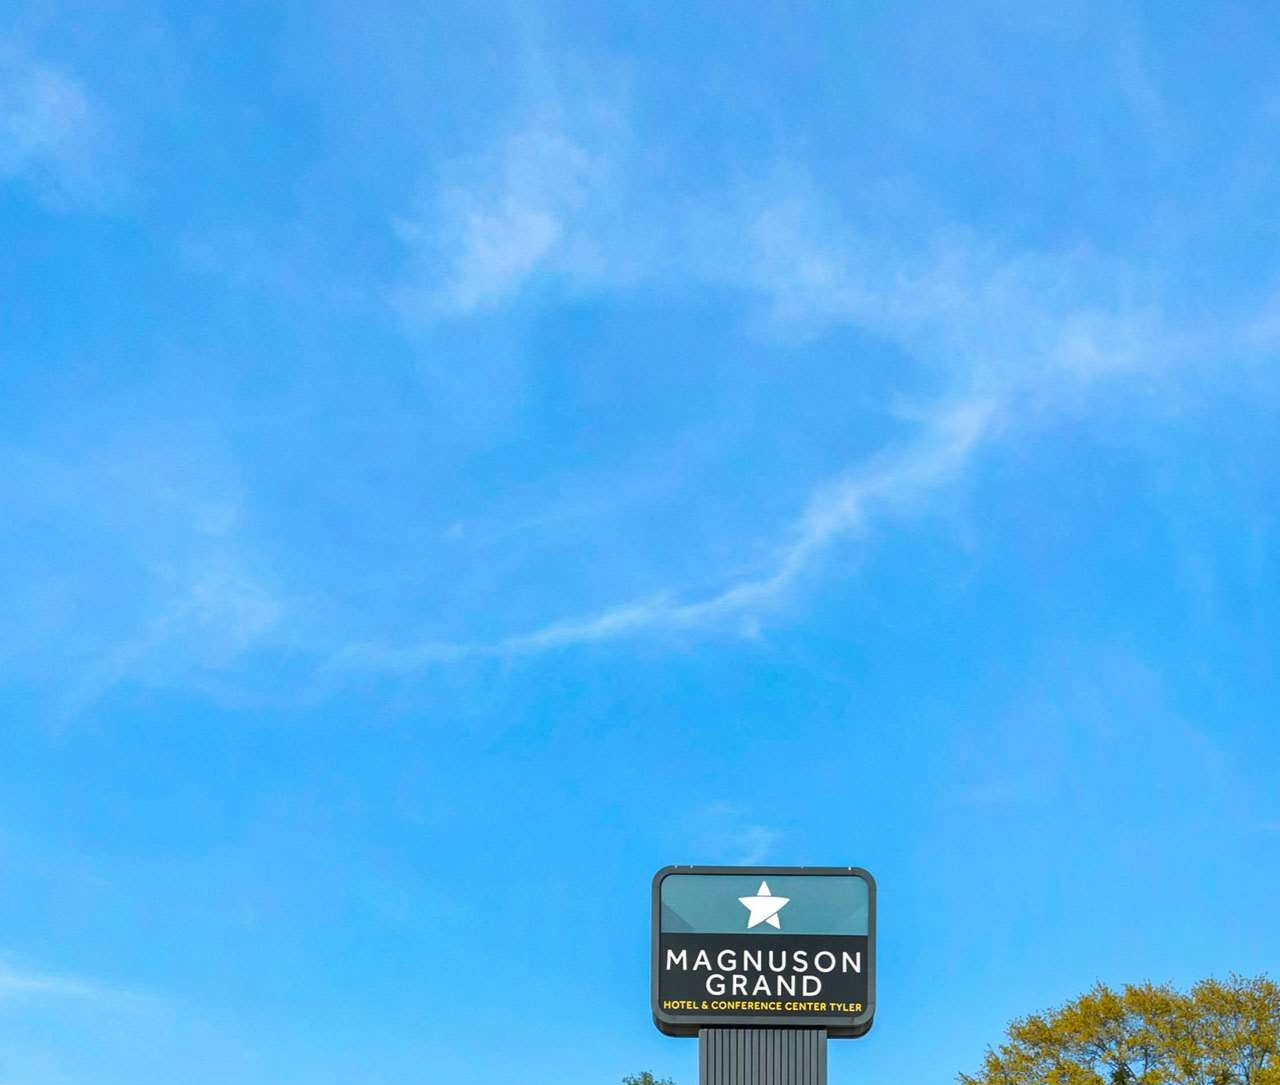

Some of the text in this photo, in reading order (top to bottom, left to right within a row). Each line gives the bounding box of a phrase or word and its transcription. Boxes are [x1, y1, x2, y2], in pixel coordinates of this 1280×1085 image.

[666, 949, 861, 973] MAGNUSON
[705, 973, 822, 997] GRAND
[663, 1000, 862, 1012] HOTEL & CONFERENCE CENTER TYLER
